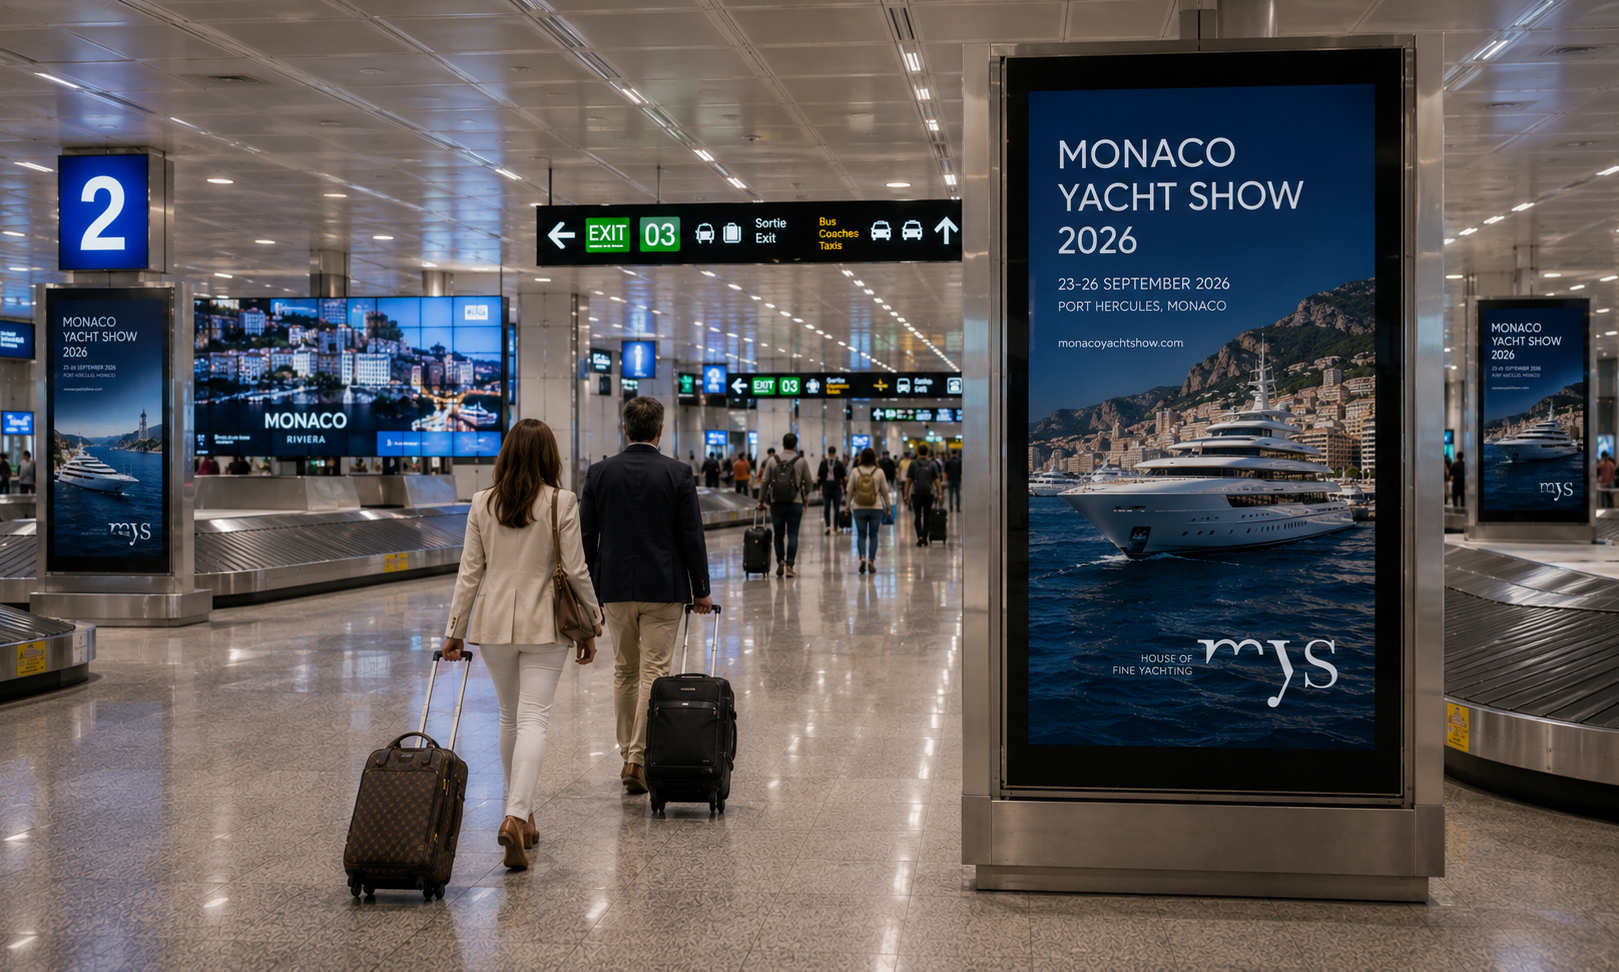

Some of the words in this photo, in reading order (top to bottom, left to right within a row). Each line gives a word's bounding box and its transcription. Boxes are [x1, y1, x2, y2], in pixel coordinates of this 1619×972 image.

[1059, 137, 1236, 169] MONACO
[1057, 182, 1178, 212] YACHT
[1188, 180, 1304, 211] SHOW
[80, 175, 126, 251] 2
[755, 217, 787, 229] Sortie
[818, 216, 837, 227] Bus
[588, 224, 627, 242] EXIT
[644, 222, 676, 247] 03
[755, 232, 777, 244] Exit
[818, 228, 860, 239] Coaches
[818, 241, 843, 251] Taxis
[1058, 225, 1137, 255] 2026
[1058, 277, 1099, 291] 23-26
[1103, 277, 1191, 291] SEPTEMBER
[1195, 276, 1231, 290] 2026
[1058, 300, 1092, 312] PORT
[1095, 300, 1164, 313] HERCULES,
[1167, 300, 1227, 312] MONACO
[62, 316, 117, 328] MONACO
[1491, 322, 1542, 333] MONACO
[63, 331, 100, 342] YACHT
[102, 331, 138, 342] SHOW
[1491, 336, 1526, 346] YACHT
[1528, 335, 1562, 347] SHOW
[1058, 337, 1184, 350] monacoyachtshow.com
[62, 346, 88, 358] 2026
[1491, 349, 1515, 360] 2026
[781, 379, 798, 393] 03
[264, 412, 348, 429] MONACO
[286, 434, 326, 444] RIVIERA
[1538, 482, 1574, 502] mys
[107, 522, 151, 546] mys
[1140, 653, 1177, 664] HOUSE
[1178, 653, 1194, 664] OF
[1111, 665, 1136, 676] FINE
[1138, 665, 1193, 676] YACHTING
[1197, 638, 1338, 708] mys
